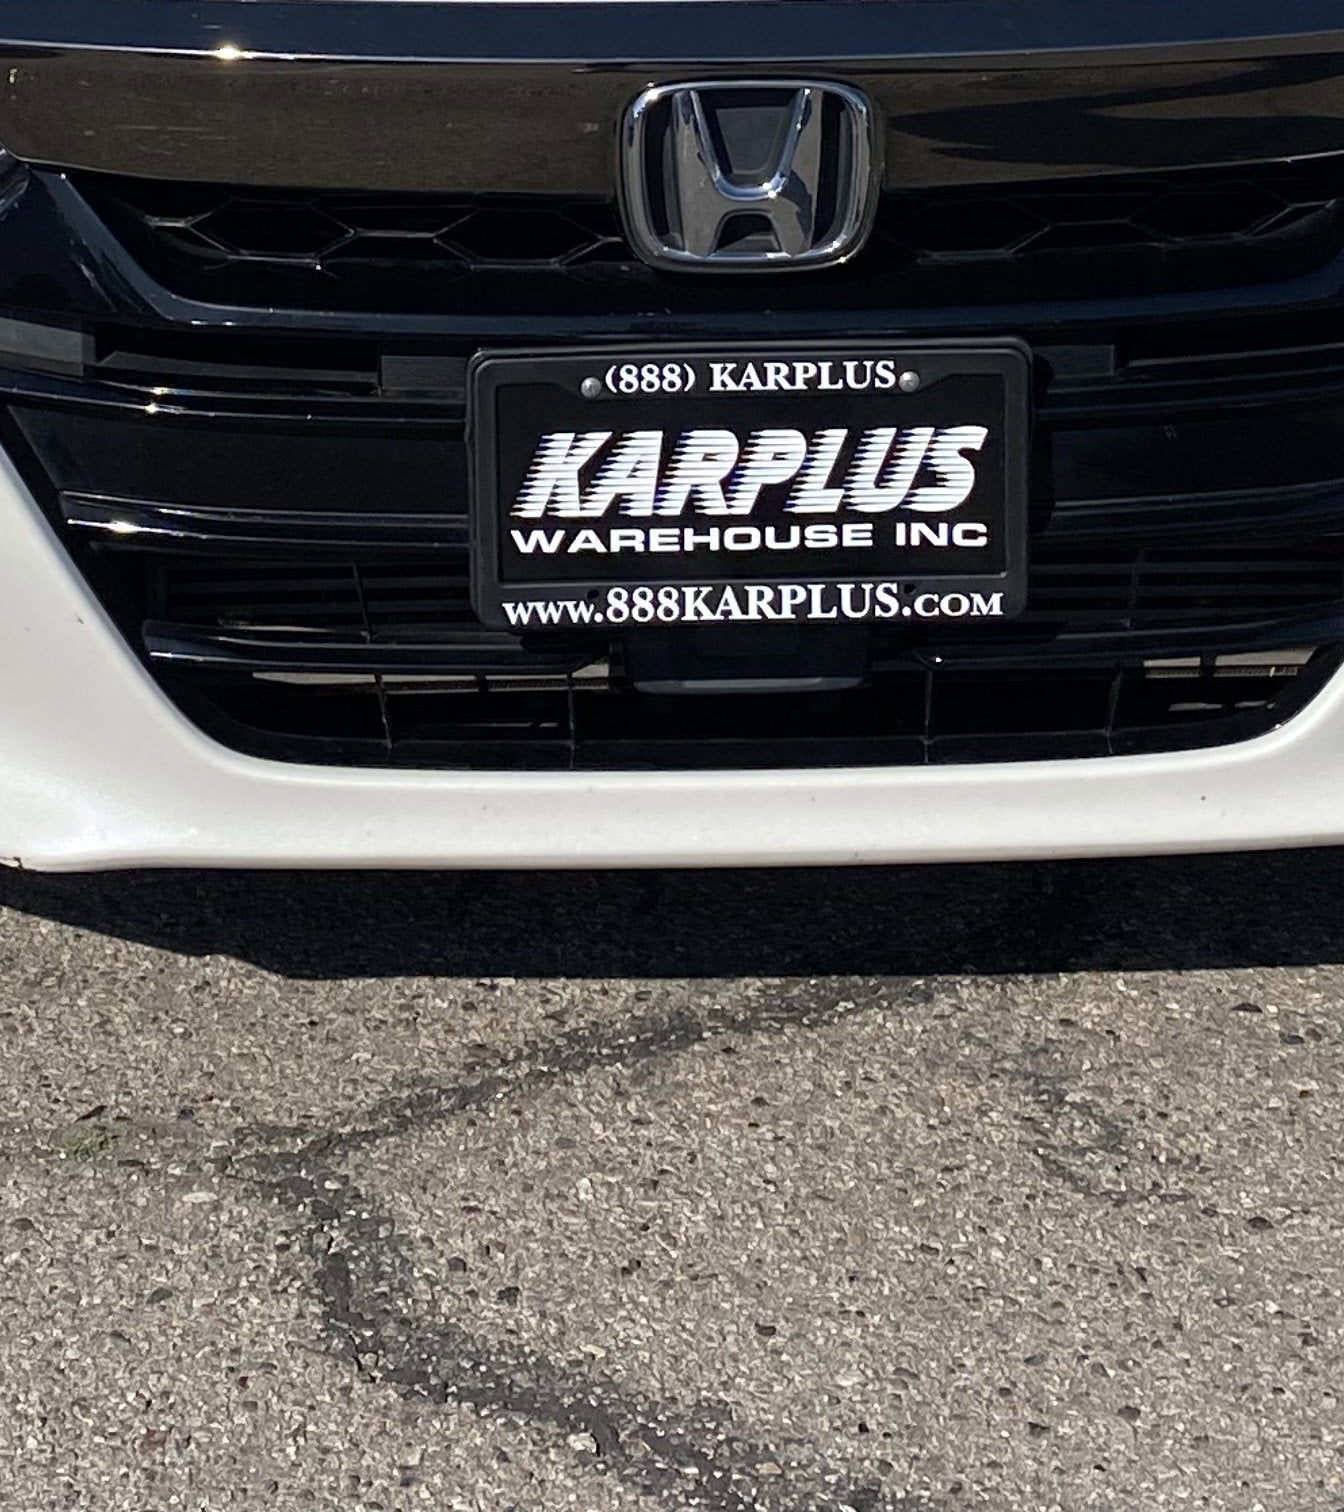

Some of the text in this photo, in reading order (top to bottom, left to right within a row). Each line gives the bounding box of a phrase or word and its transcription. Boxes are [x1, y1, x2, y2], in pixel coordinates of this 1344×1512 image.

[605, 360, 896, 394] (888) KARPLUS
[509, 425, 989, 518] KARPLUS
[509, 522, 988, 554] WAREHOUSE INC
